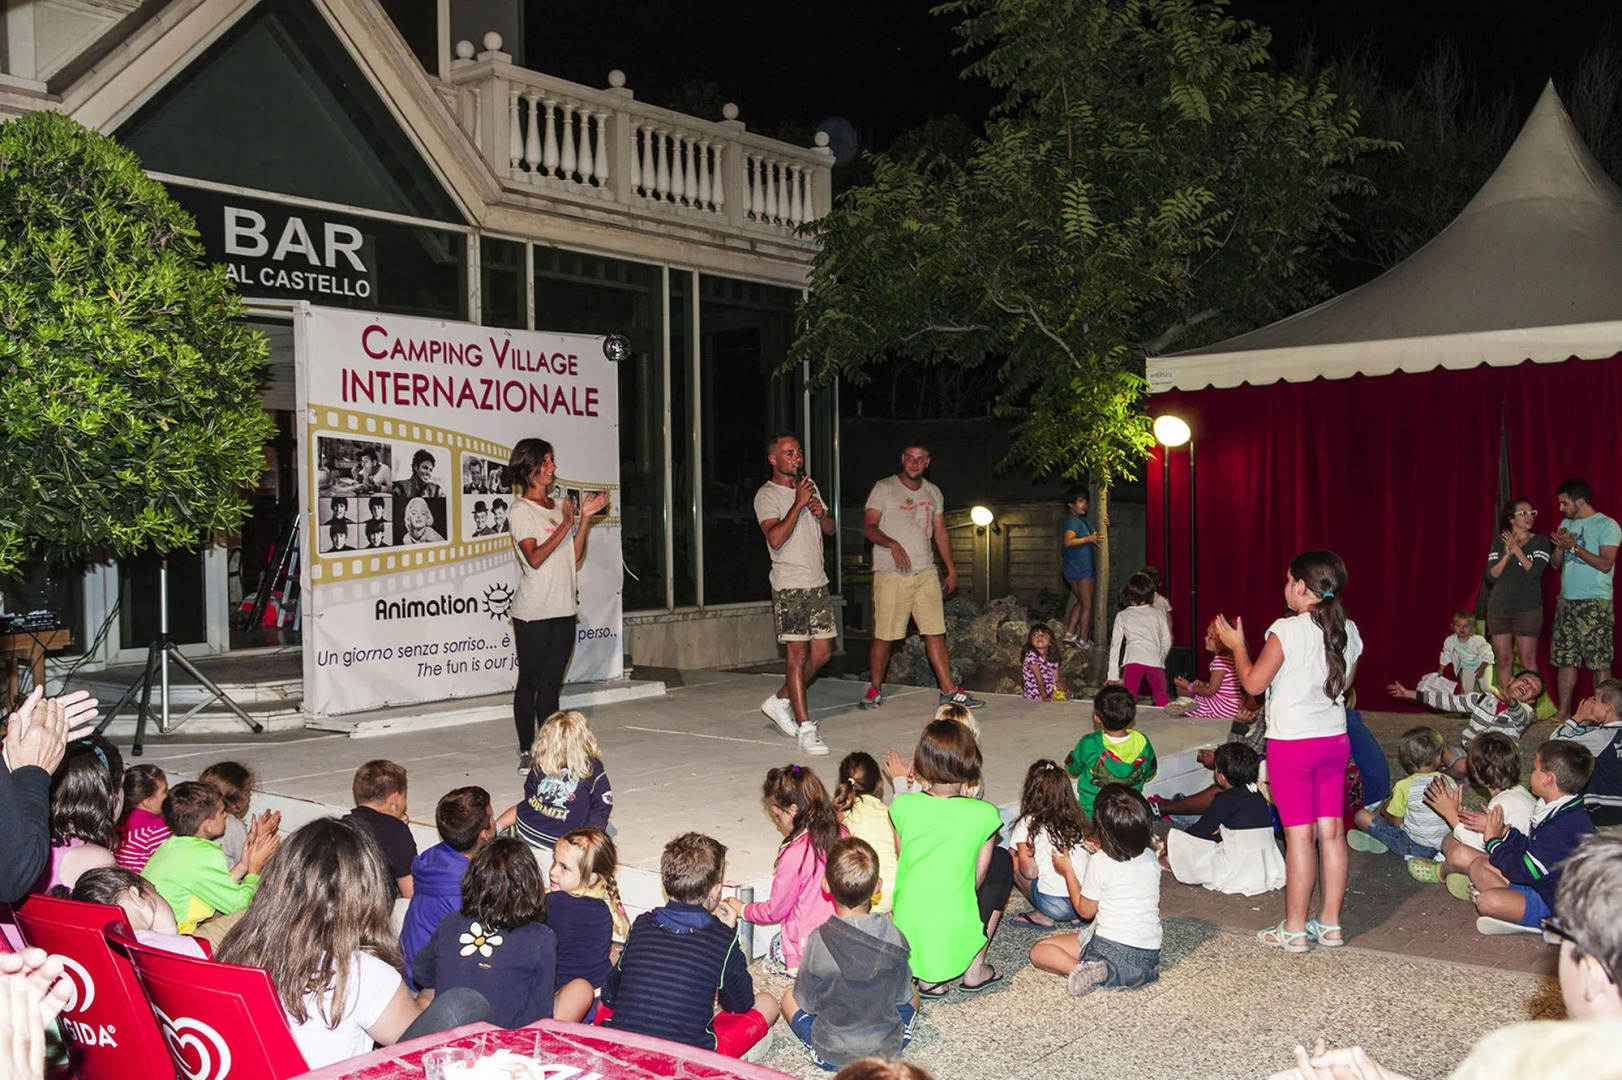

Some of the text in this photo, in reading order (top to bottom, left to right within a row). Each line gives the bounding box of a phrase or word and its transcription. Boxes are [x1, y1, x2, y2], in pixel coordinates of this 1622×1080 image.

[224, 206, 368, 273] BAR
[226, 263, 371, 298] AL CASTELLO
[361, 324, 578, 376] CAMPING VILLAGE
[341, 368, 599, 417] INTERNAZIONALE
[375, 596, 478, 621] Animation
[317, 651, 339, 667] Un
[342, 647, 393, 667] giorno
[397, 644, 439, 659] senza
[442, 637, 498, 654] sorriso...
[501, 633, 511, 648] è
[417, 662, 442, 678] The
[446, 660, 468, 675] fun
[471, 657, 481, 672] is
[484, 655, 507, 670] our
